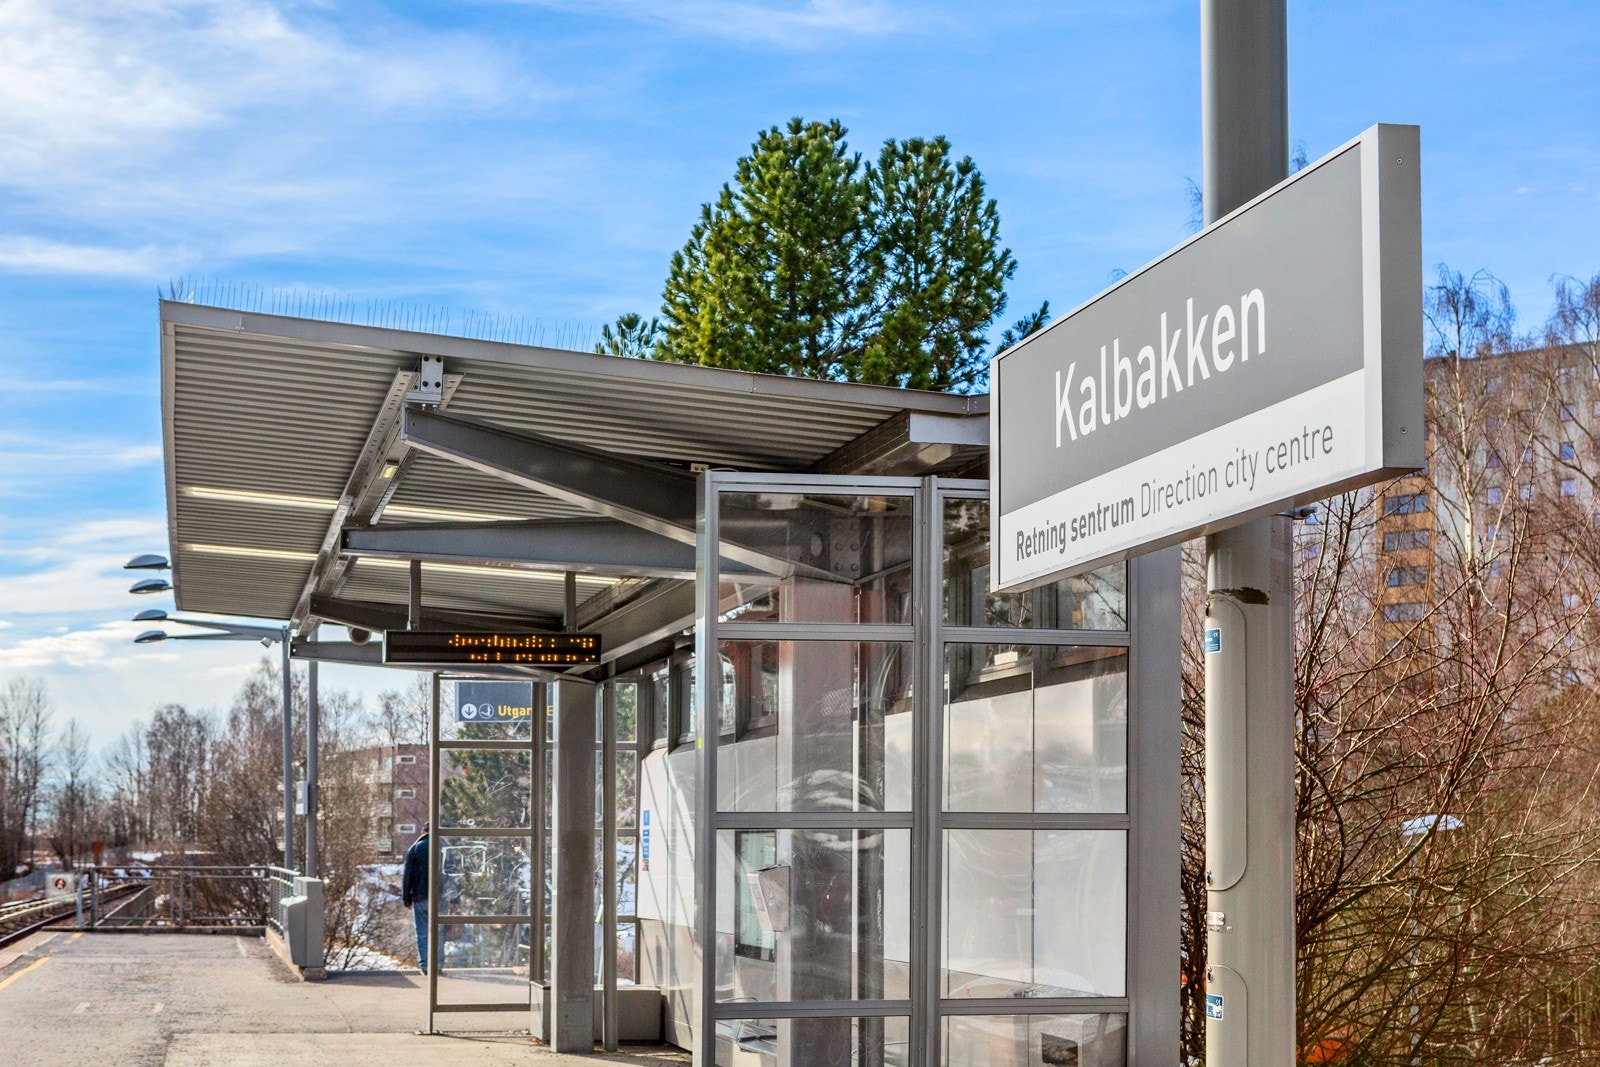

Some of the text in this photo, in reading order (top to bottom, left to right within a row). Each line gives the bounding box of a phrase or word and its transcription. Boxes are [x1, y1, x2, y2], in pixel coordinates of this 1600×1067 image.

[1055, 288, 1266, 448] Kalbakken
[1016, 424, 1334, 561] Retning sentrum Direction city centre
